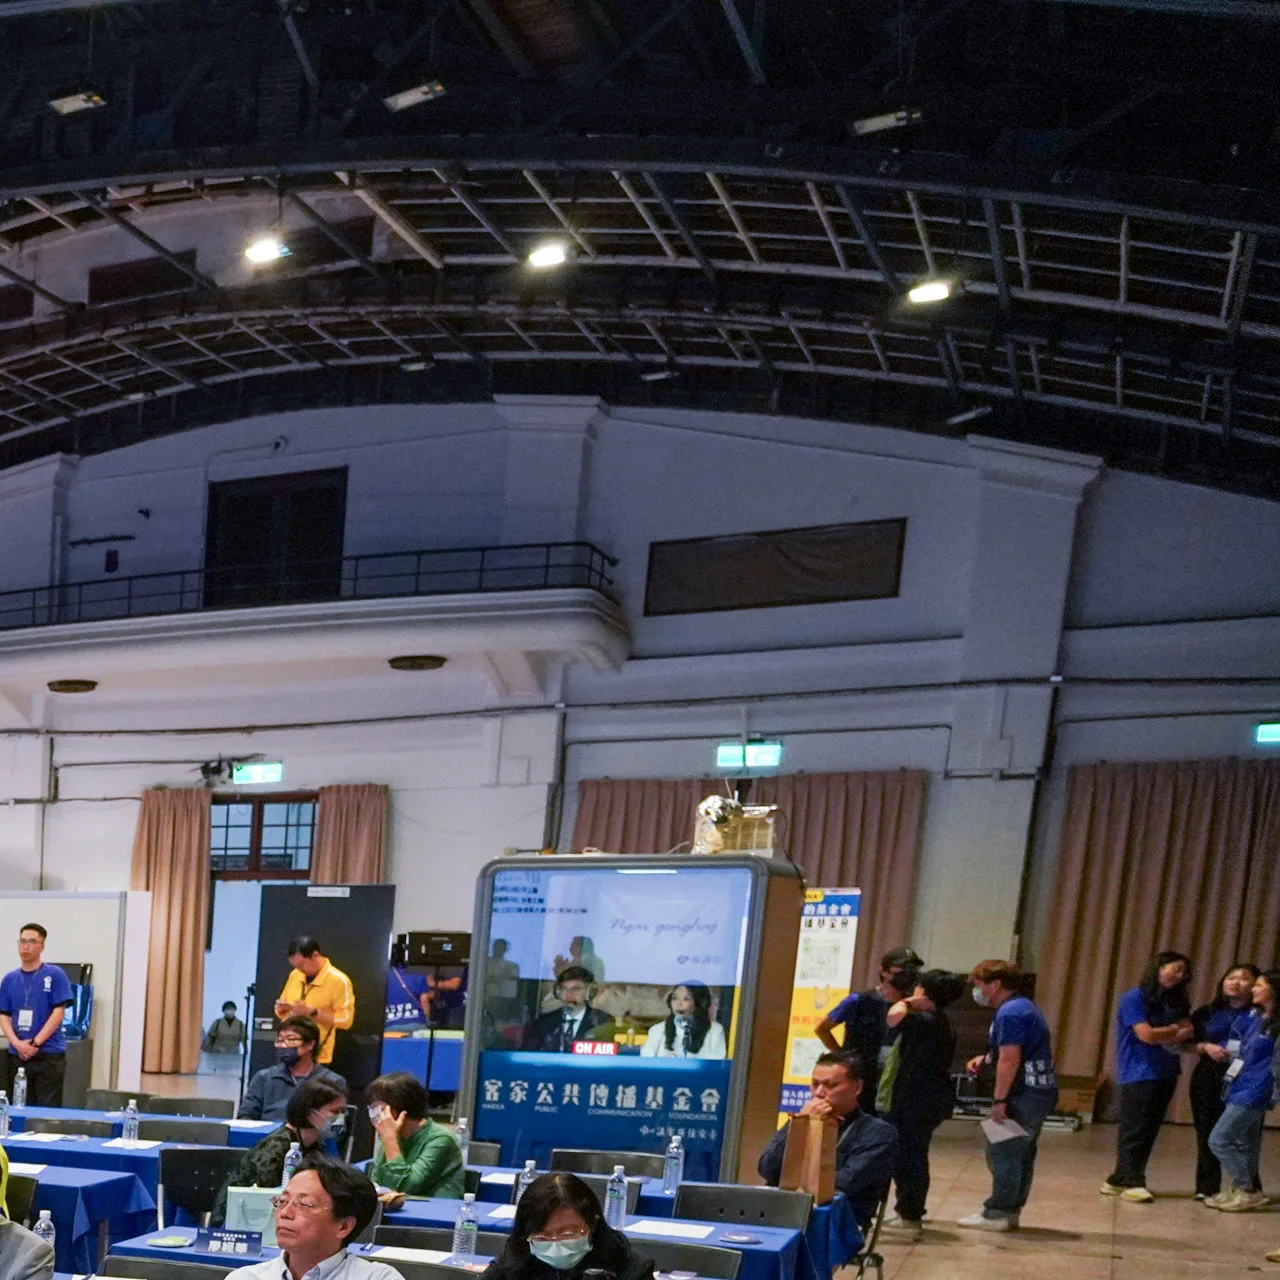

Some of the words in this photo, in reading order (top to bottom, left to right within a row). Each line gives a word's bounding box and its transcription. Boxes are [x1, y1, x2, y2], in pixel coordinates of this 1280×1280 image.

[575, 1042, 591, 1054] ON
[594, 1043, 615, 1055] AIR
[484, 1079, 721, 1112] 客家公共傳播基金會
